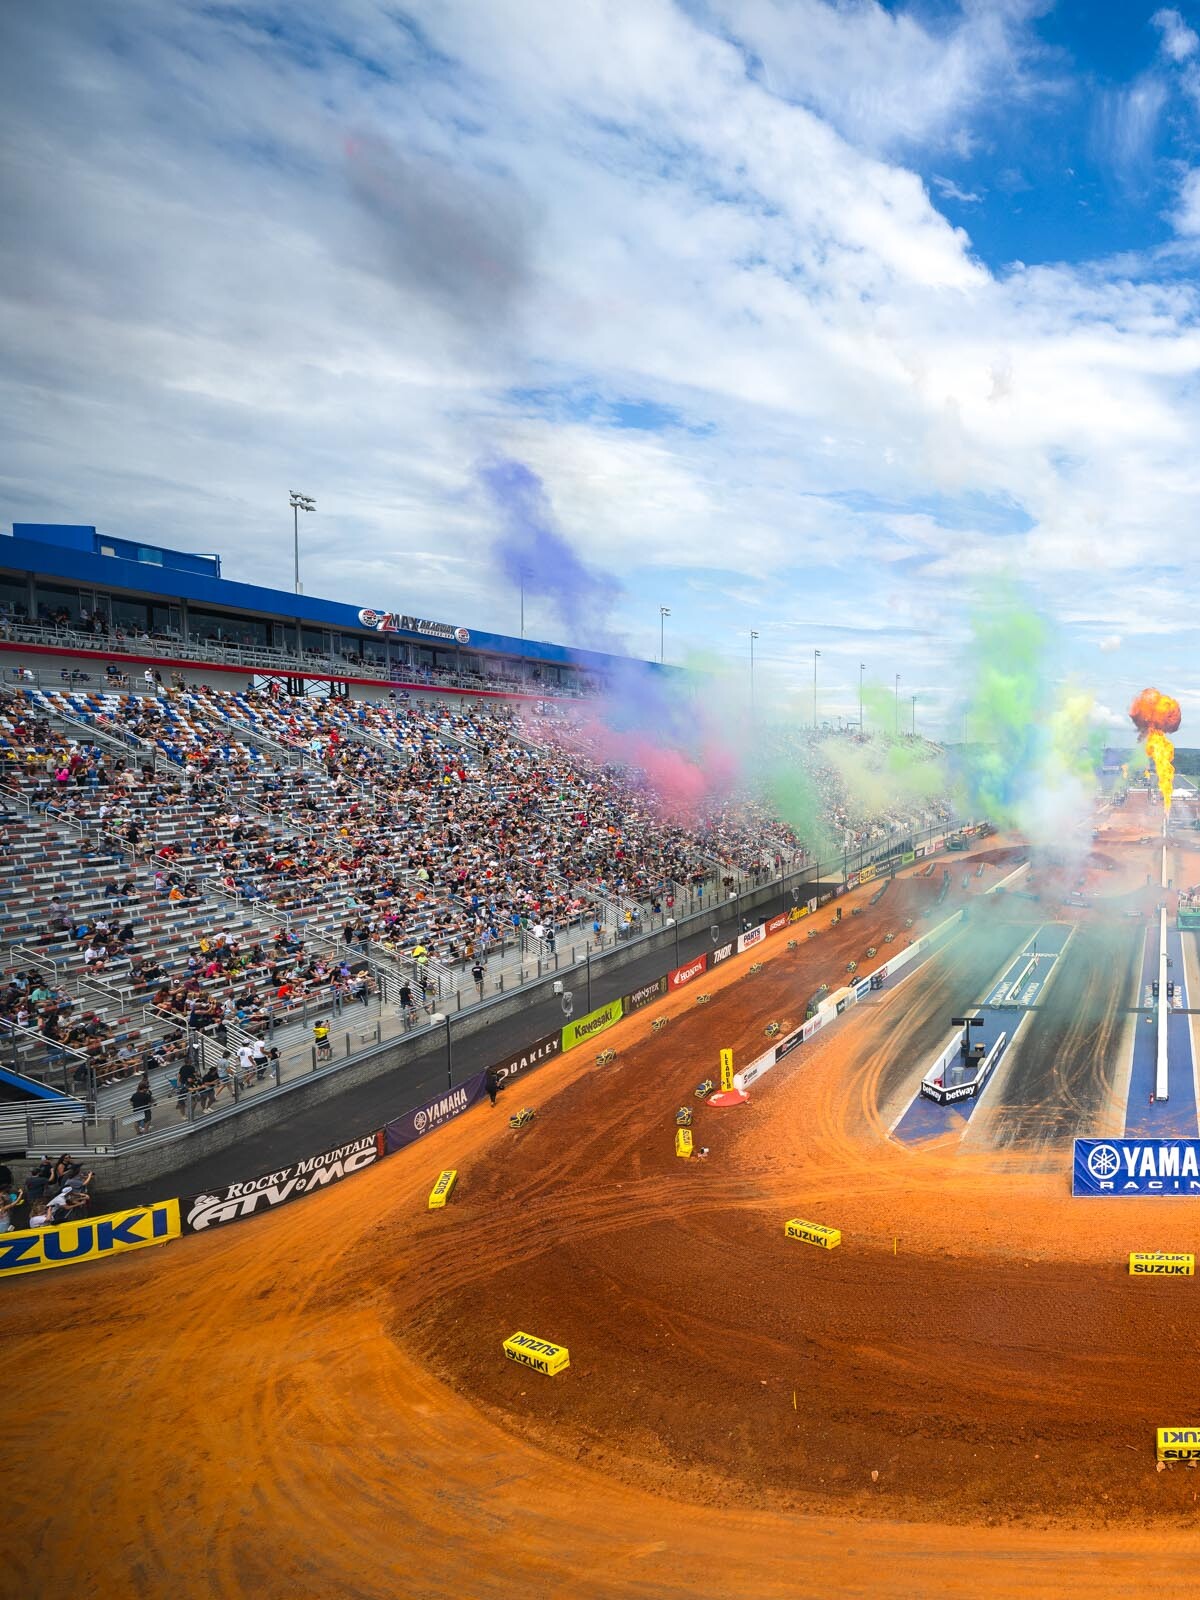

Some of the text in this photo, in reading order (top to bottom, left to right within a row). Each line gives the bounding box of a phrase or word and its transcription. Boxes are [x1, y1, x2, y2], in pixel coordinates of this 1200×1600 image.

[744, 927, 761, 944] PARTS
[714, 943, 732, 965] THOR
[680, 962, 703, 981] HONDA
[574, 1013, 613, 1039] Kawasaki
[510, 1039, 559, 1075] OAKLEY
[922, 1084, 942, 1101] betway
[945, 1085, 976, 1101] betway
[426, 1088, 468, 1123] YAMAHA
[225, 1166, 292, 1201] ROCKY
[297, 1134, 376, 1175] MOUNTAIN
[304, 1146, 377, 1193] MC
[788, 1227, 828, 1247] SUZUKI
[1133, 1264, 1190, 1274] SUZUKI
[509, 1335, 560, 1357] SUZUKI
[506, 1348, 549, 1373] SUZUKI
